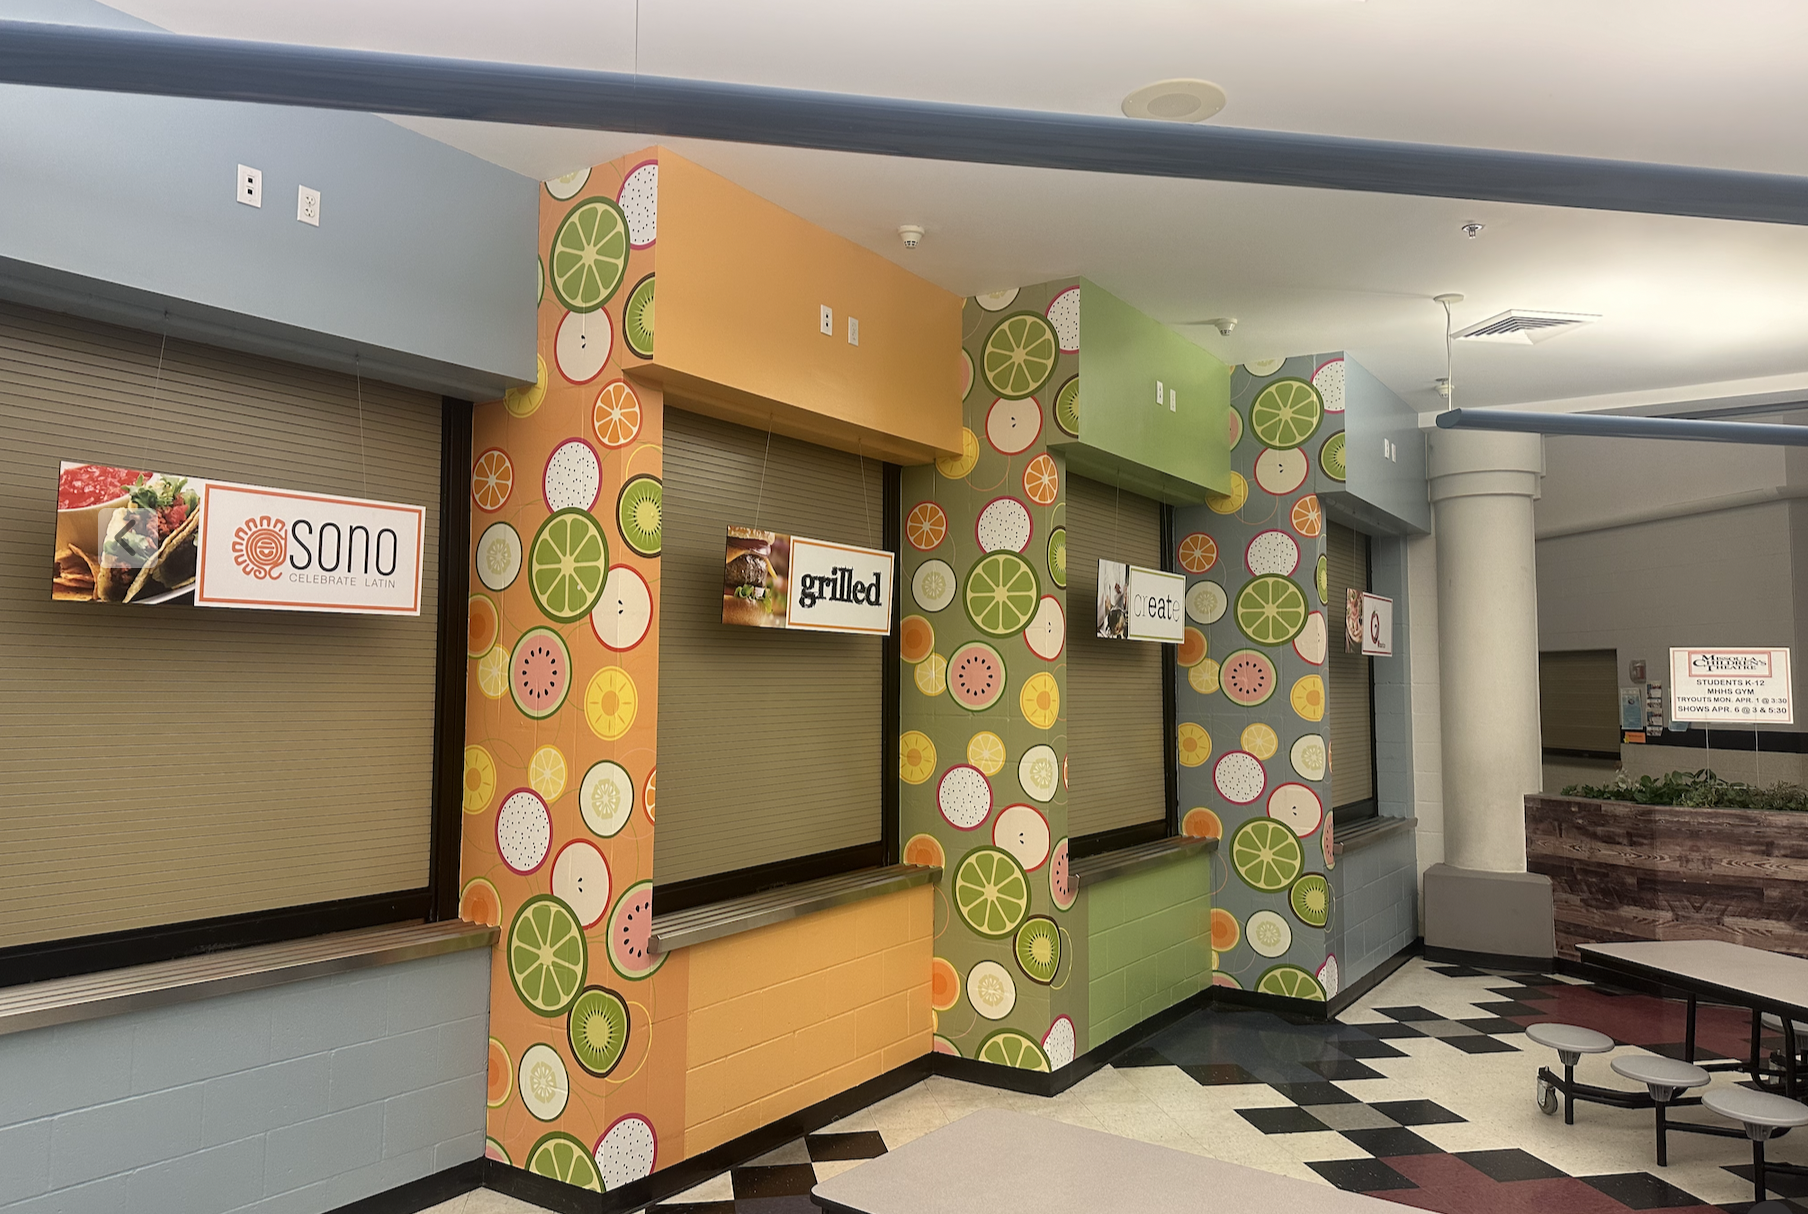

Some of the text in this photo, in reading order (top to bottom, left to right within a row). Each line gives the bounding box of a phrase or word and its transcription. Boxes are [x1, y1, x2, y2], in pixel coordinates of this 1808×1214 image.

[289, 572, 396, 589] CELEBRATE LATIN
[799, 566, 882, 609] grilled
[1133, 593, 1180, 622] create
[1741, 706, 1751, 715] @
[1759, 706, 1766, 714] &
